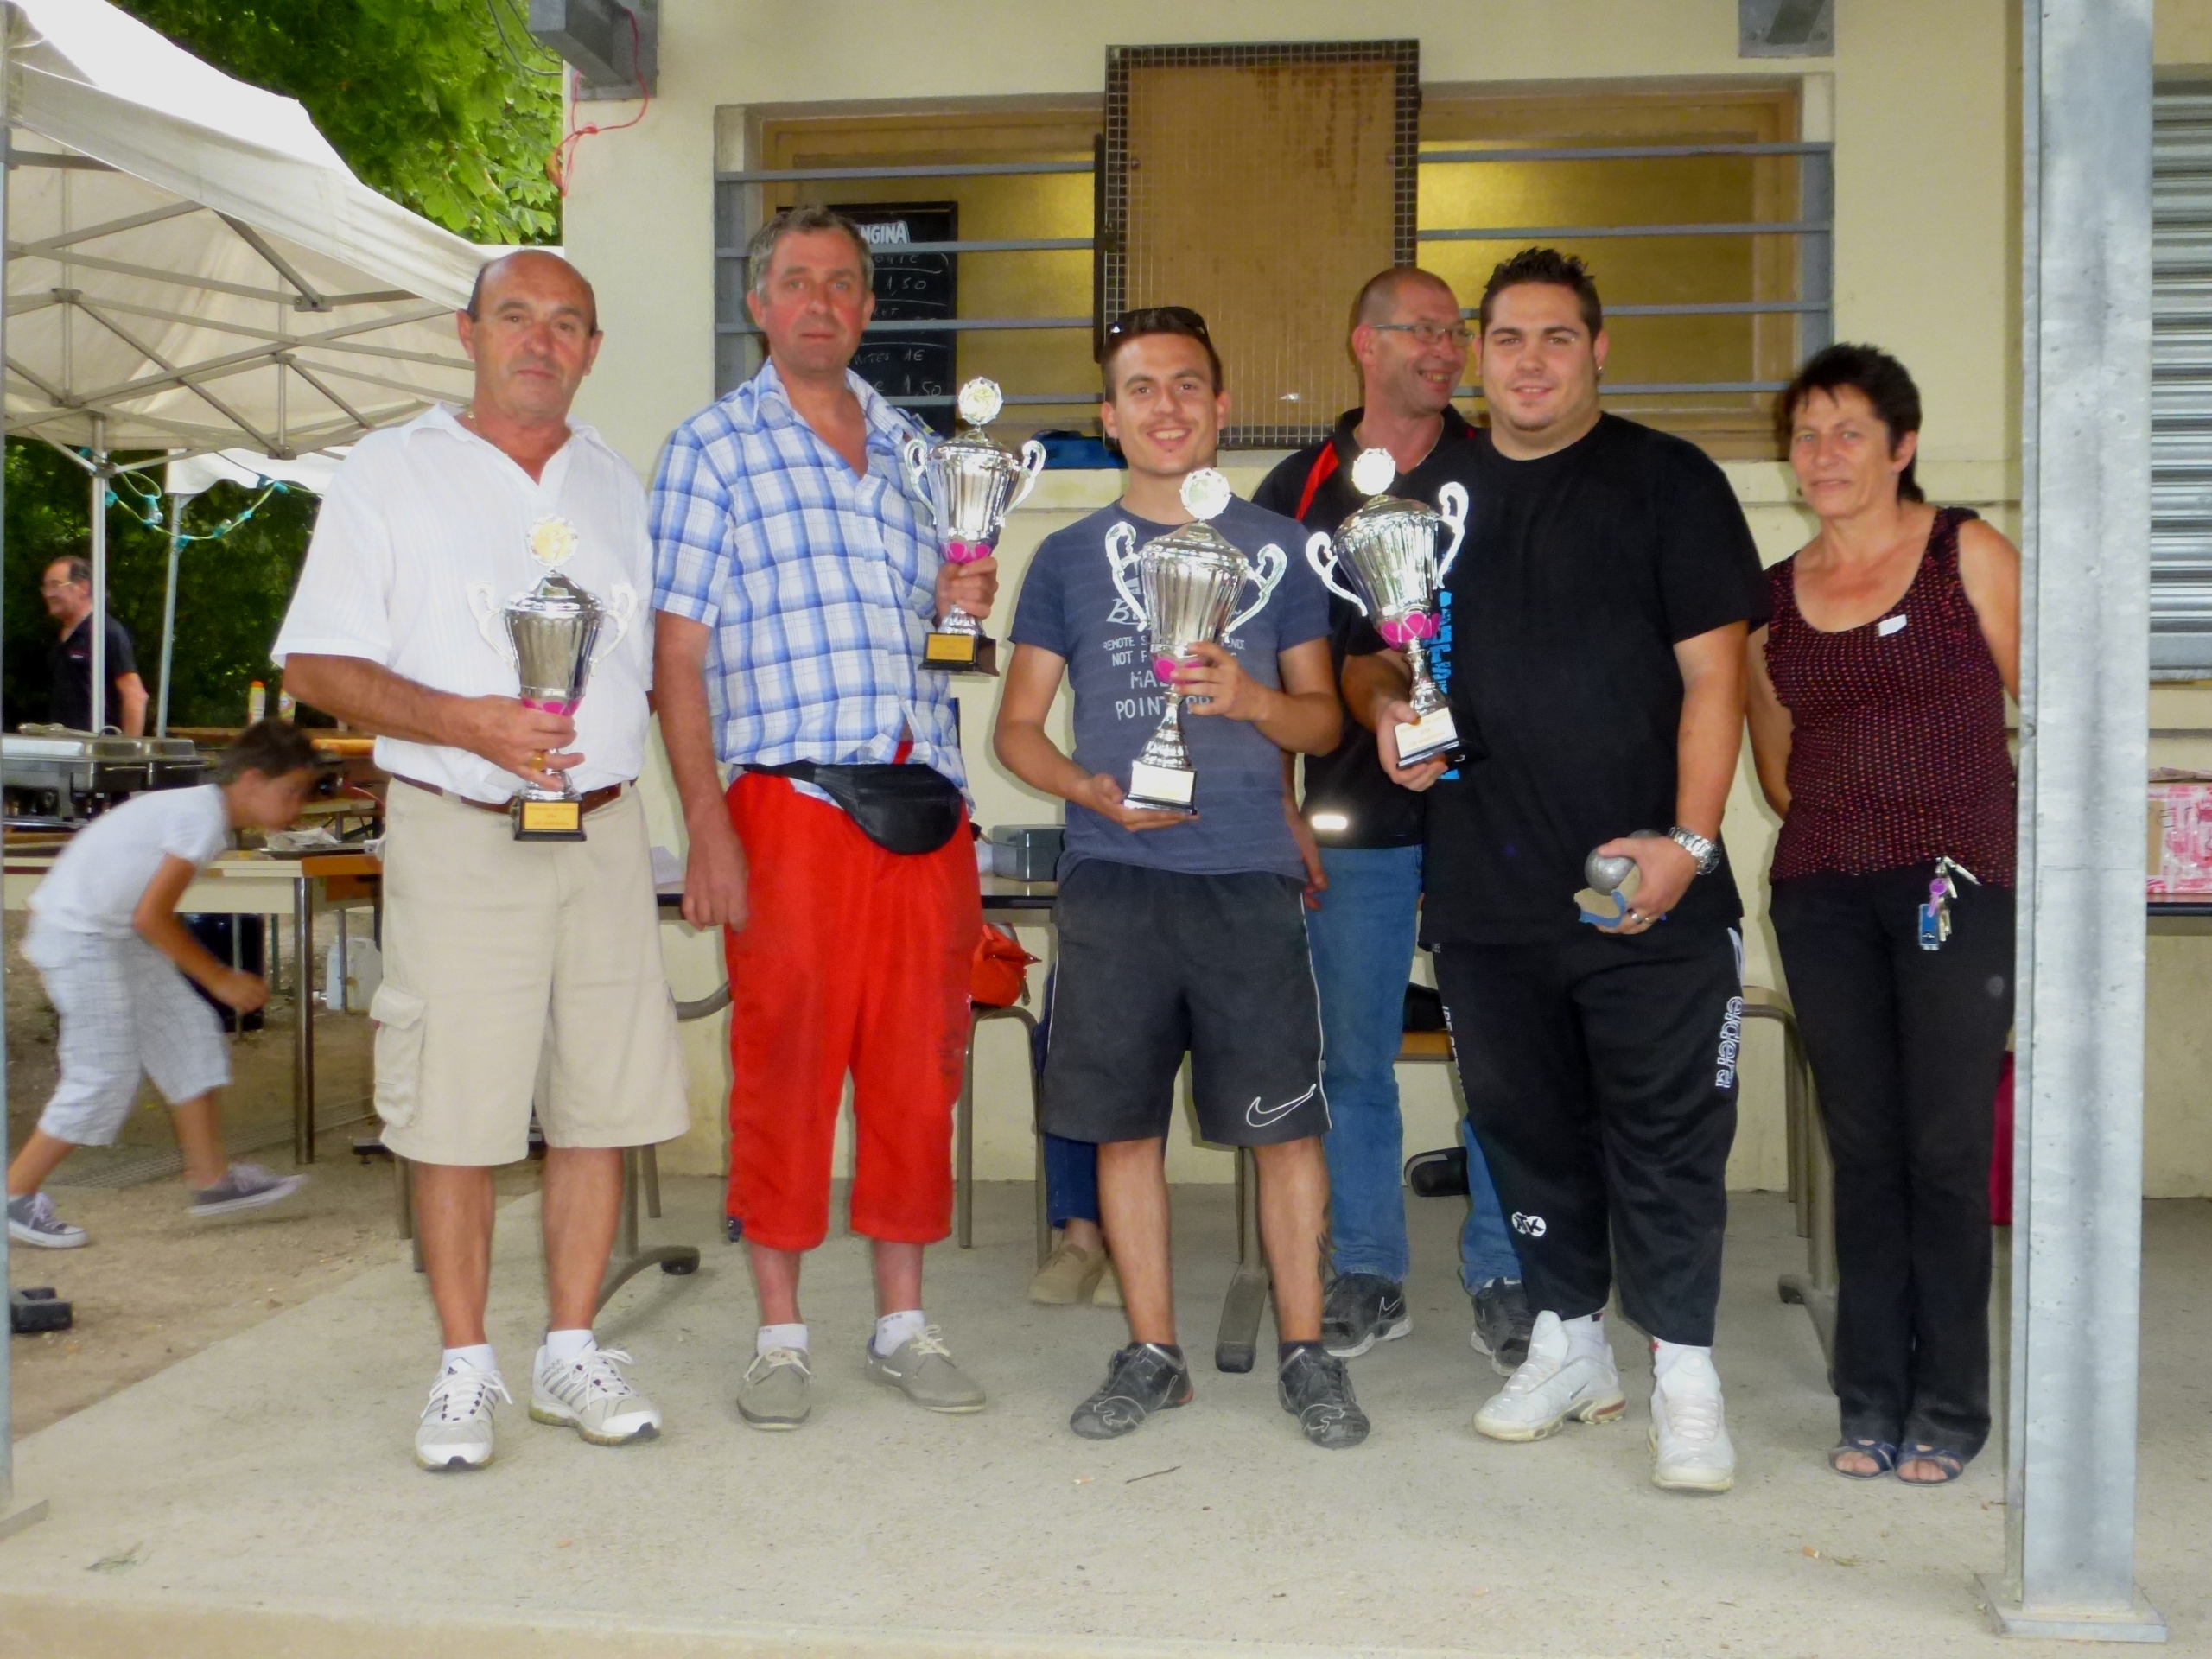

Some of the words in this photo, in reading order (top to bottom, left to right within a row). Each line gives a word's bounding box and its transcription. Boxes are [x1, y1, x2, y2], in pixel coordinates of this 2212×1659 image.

[861, 222, 908, 244] NGINA
[1103, 635, 1135, 651] REMOTE
[1111, 650, 1134, 667] NOT
